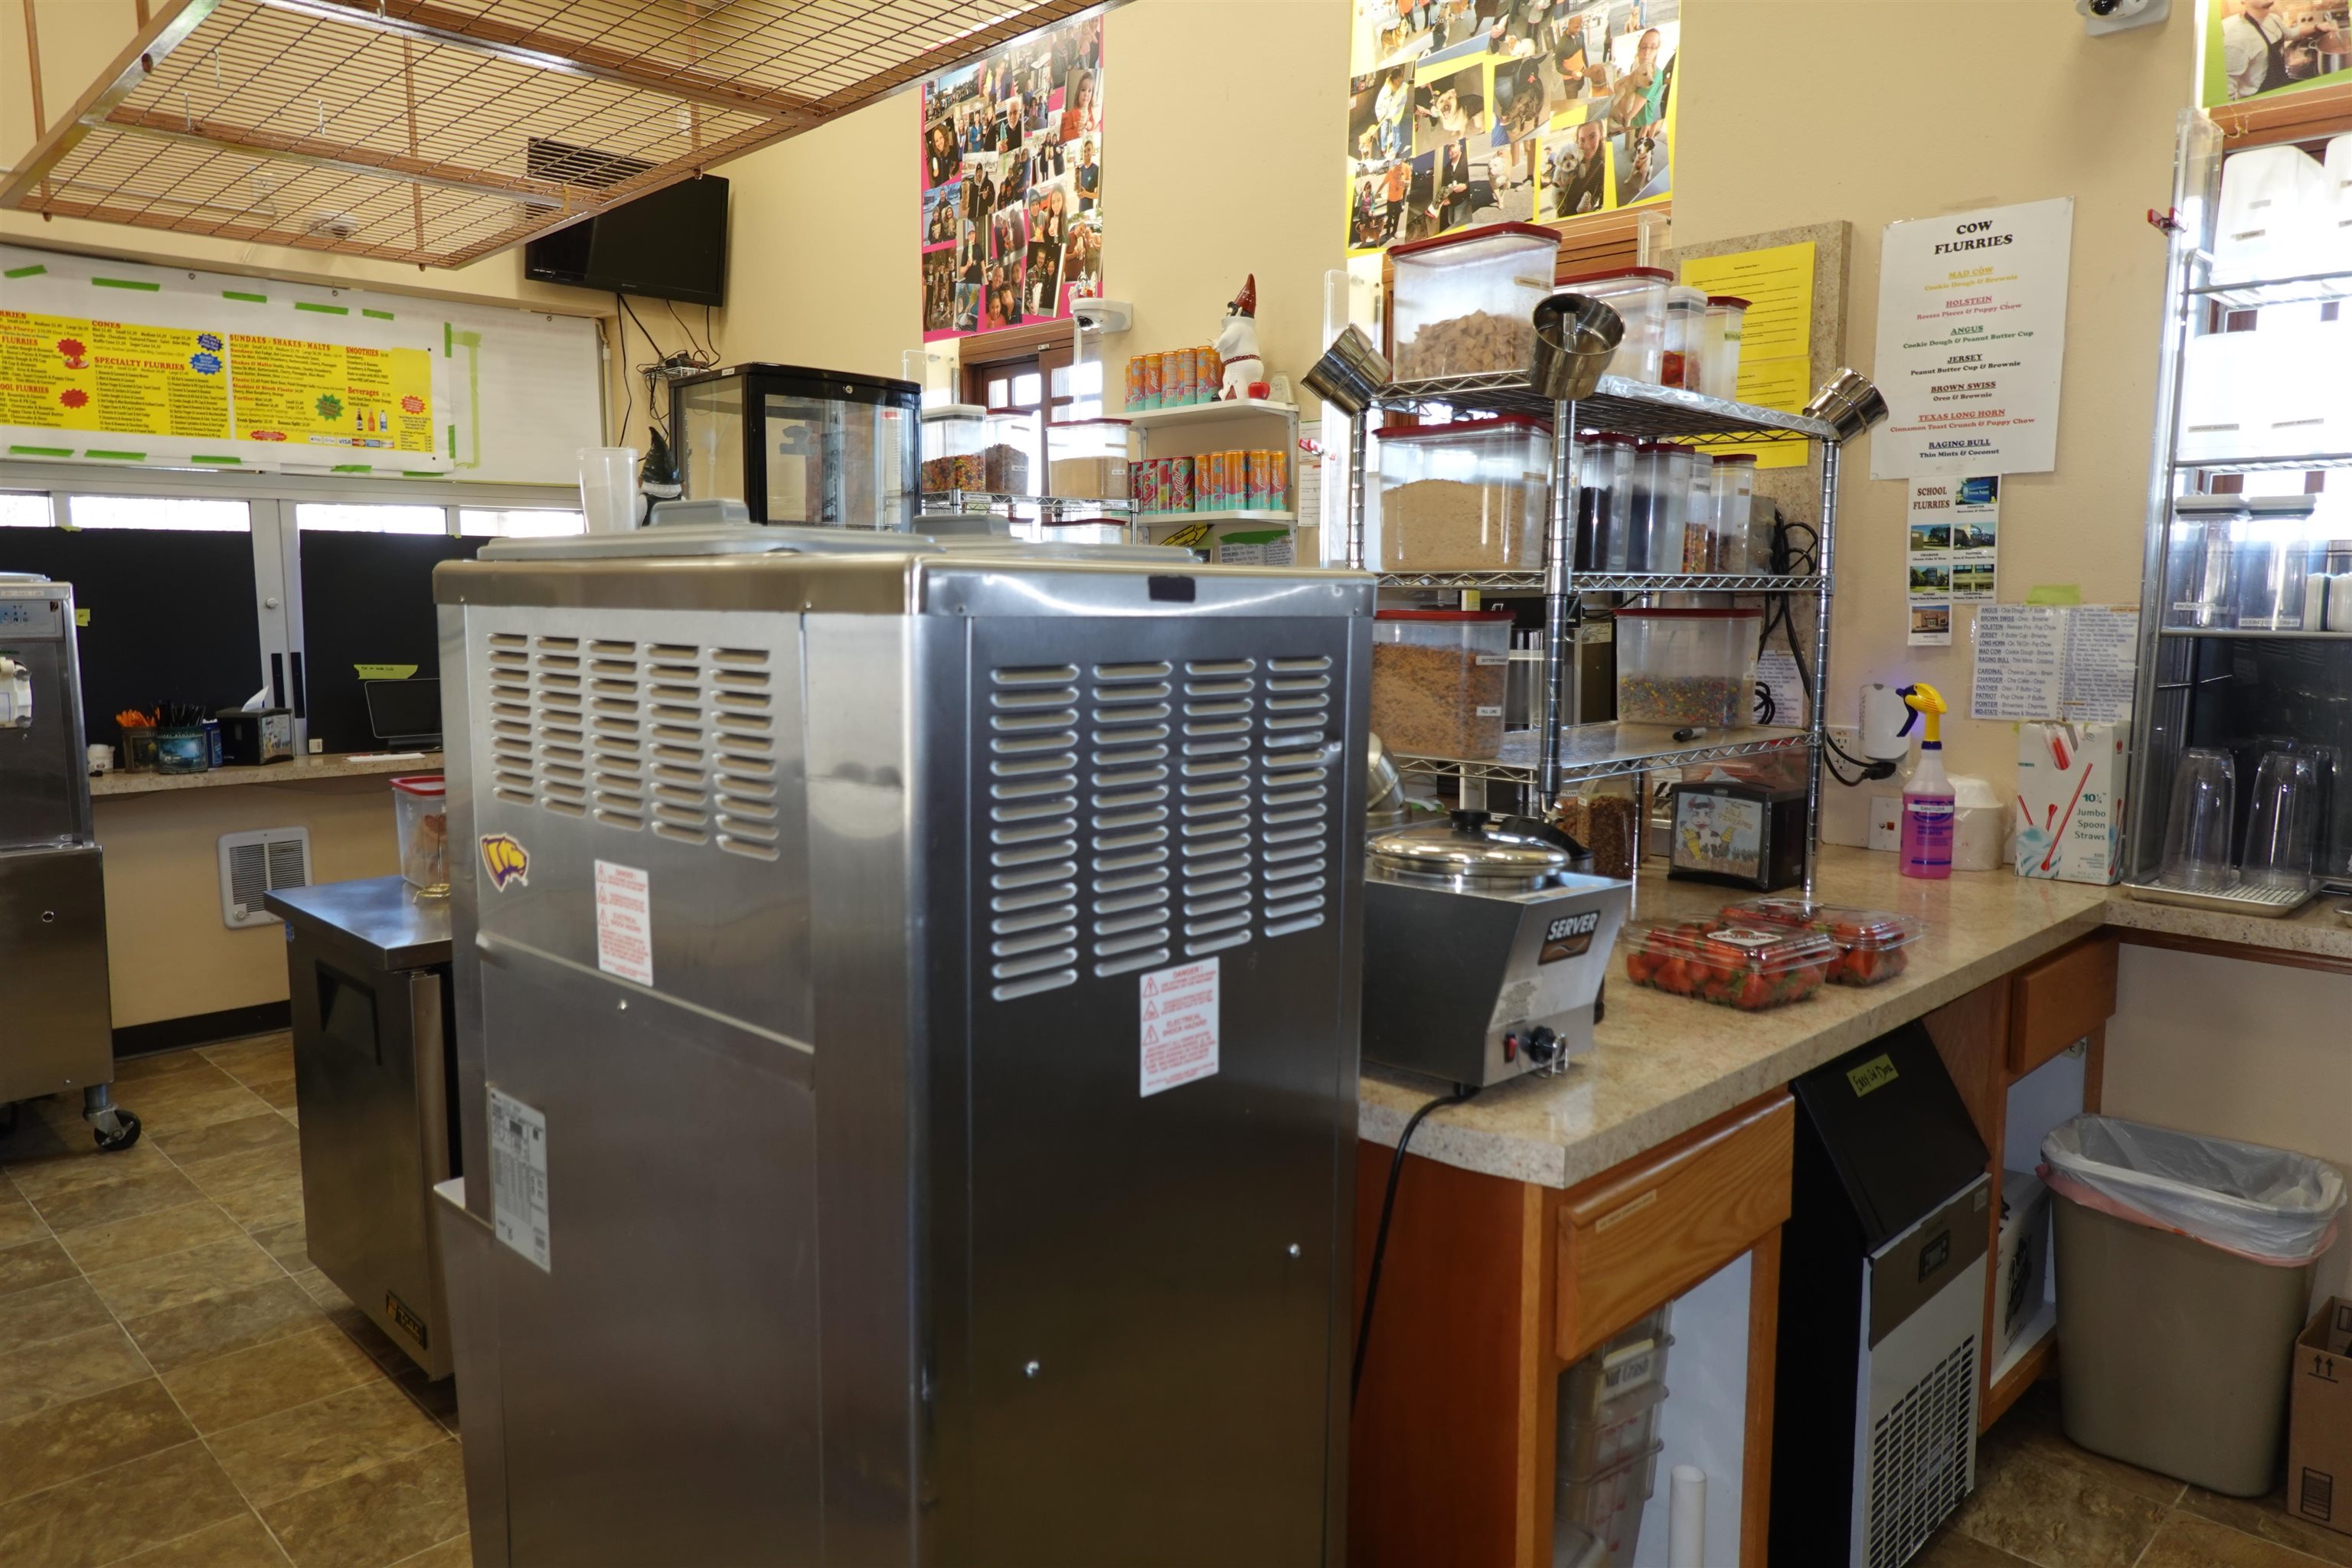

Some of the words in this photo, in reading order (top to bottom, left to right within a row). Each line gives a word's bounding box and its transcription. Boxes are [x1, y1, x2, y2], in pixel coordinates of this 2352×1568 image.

[1956, 220, 1992, 234] COW
[1935, 234, 2013, 254] FLURRIES
[1949, 270, 1969, 279] MAD
[1972, 267, 1994, 276] COW
[1925, 283, 1949, 291] Cookie
[1952, 279, 1975, 288] Dough
[1985, 275, 2018, 283] Brownie
[1946, 296, 1992, 308] HOLSTEIN
[92, 320, 121, 328] CONES
[1951, 325, 1984, 335] ANGUS
[2, 336, 38, 345] FLURRIES
[230, 334, 266, 344] SUNDAES
[273, 338, 302, 348] SHAKES
[307, 342, 331, 351] MALTS
[346, 347, 378, 357] SMOOTHIES
[94, 356, 141, 367] SPECIALTY
[144, 361, 185, 371] FLURRIES
[1948, 354, 1983, 363] JERSEY
[16, 385, 49, 394] FLURRIES
[348, 387, 379, 397] Beverages
[1931, 384, 1964, 393] BROWN
[1968, 381, 1996, 390] SWISS
[1919, 413, 1948, 422] TEXAS
[1951, 411, 1975, 420] LONG
[1978, 409, 2005, 417] HORN
[1929, 440, 1964, 449] RAGING
[1967, 439, 1991, 447] BULL
[1917, 487, 1947, 496] SCHOOL
[1913, 500, 1950, 510] FLURRIES
[2076, 808, 2105, 817] Jumbo
[2078, 820, 2105, 829] Spoon
[2075, 831, 2105, 840] Straws
[1548, 913, 1598, 941] SERVER
[1173, 966, 1200, 979] DANGER
